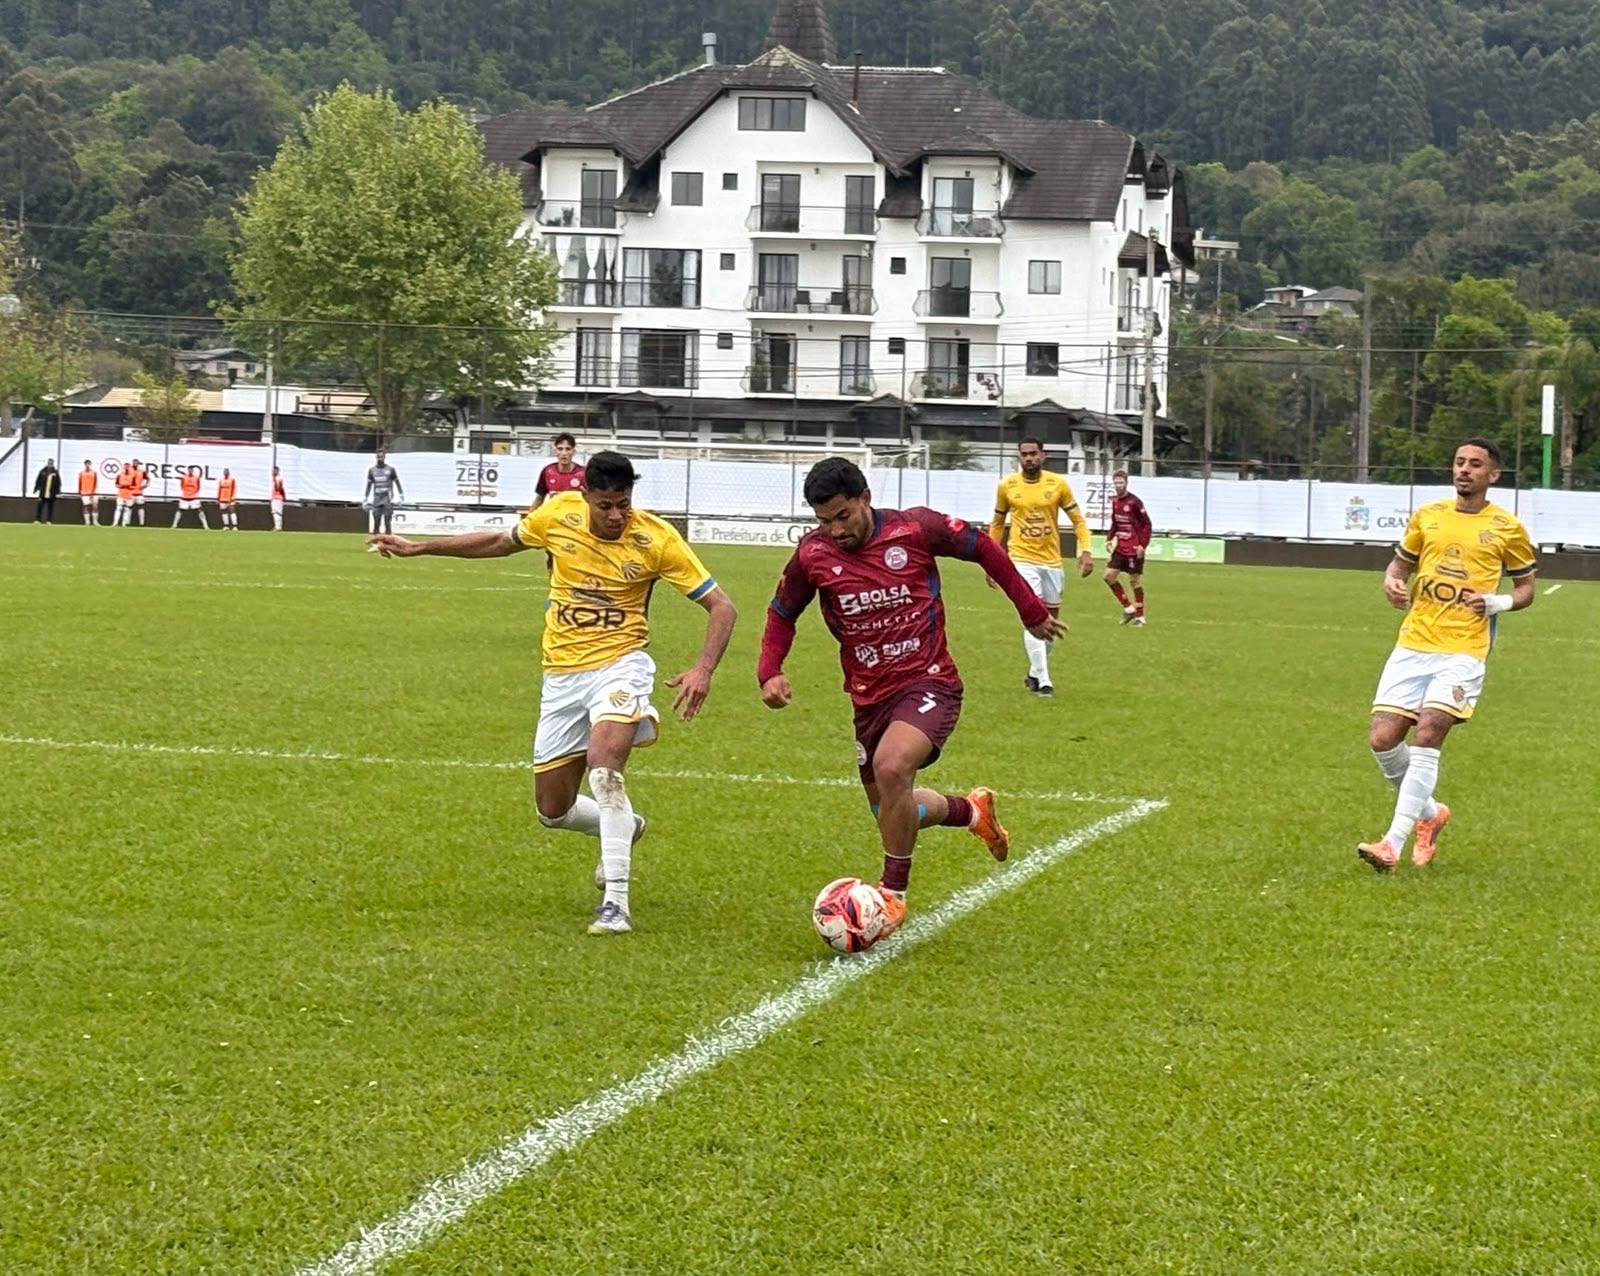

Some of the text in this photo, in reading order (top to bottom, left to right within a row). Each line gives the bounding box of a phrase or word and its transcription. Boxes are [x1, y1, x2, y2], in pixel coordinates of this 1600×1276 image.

[136, 462, 216, 480] RESOL
[456, 467, 498, 483] ZERO
[1086, 489, 1115, 504] ZER
[1377, 516, 1409, 528] GRA
[711, 527, 768, 542] Prefeitura
[770, 529, 785, 542] de
[859, 584, 912, 605] BOLSA
